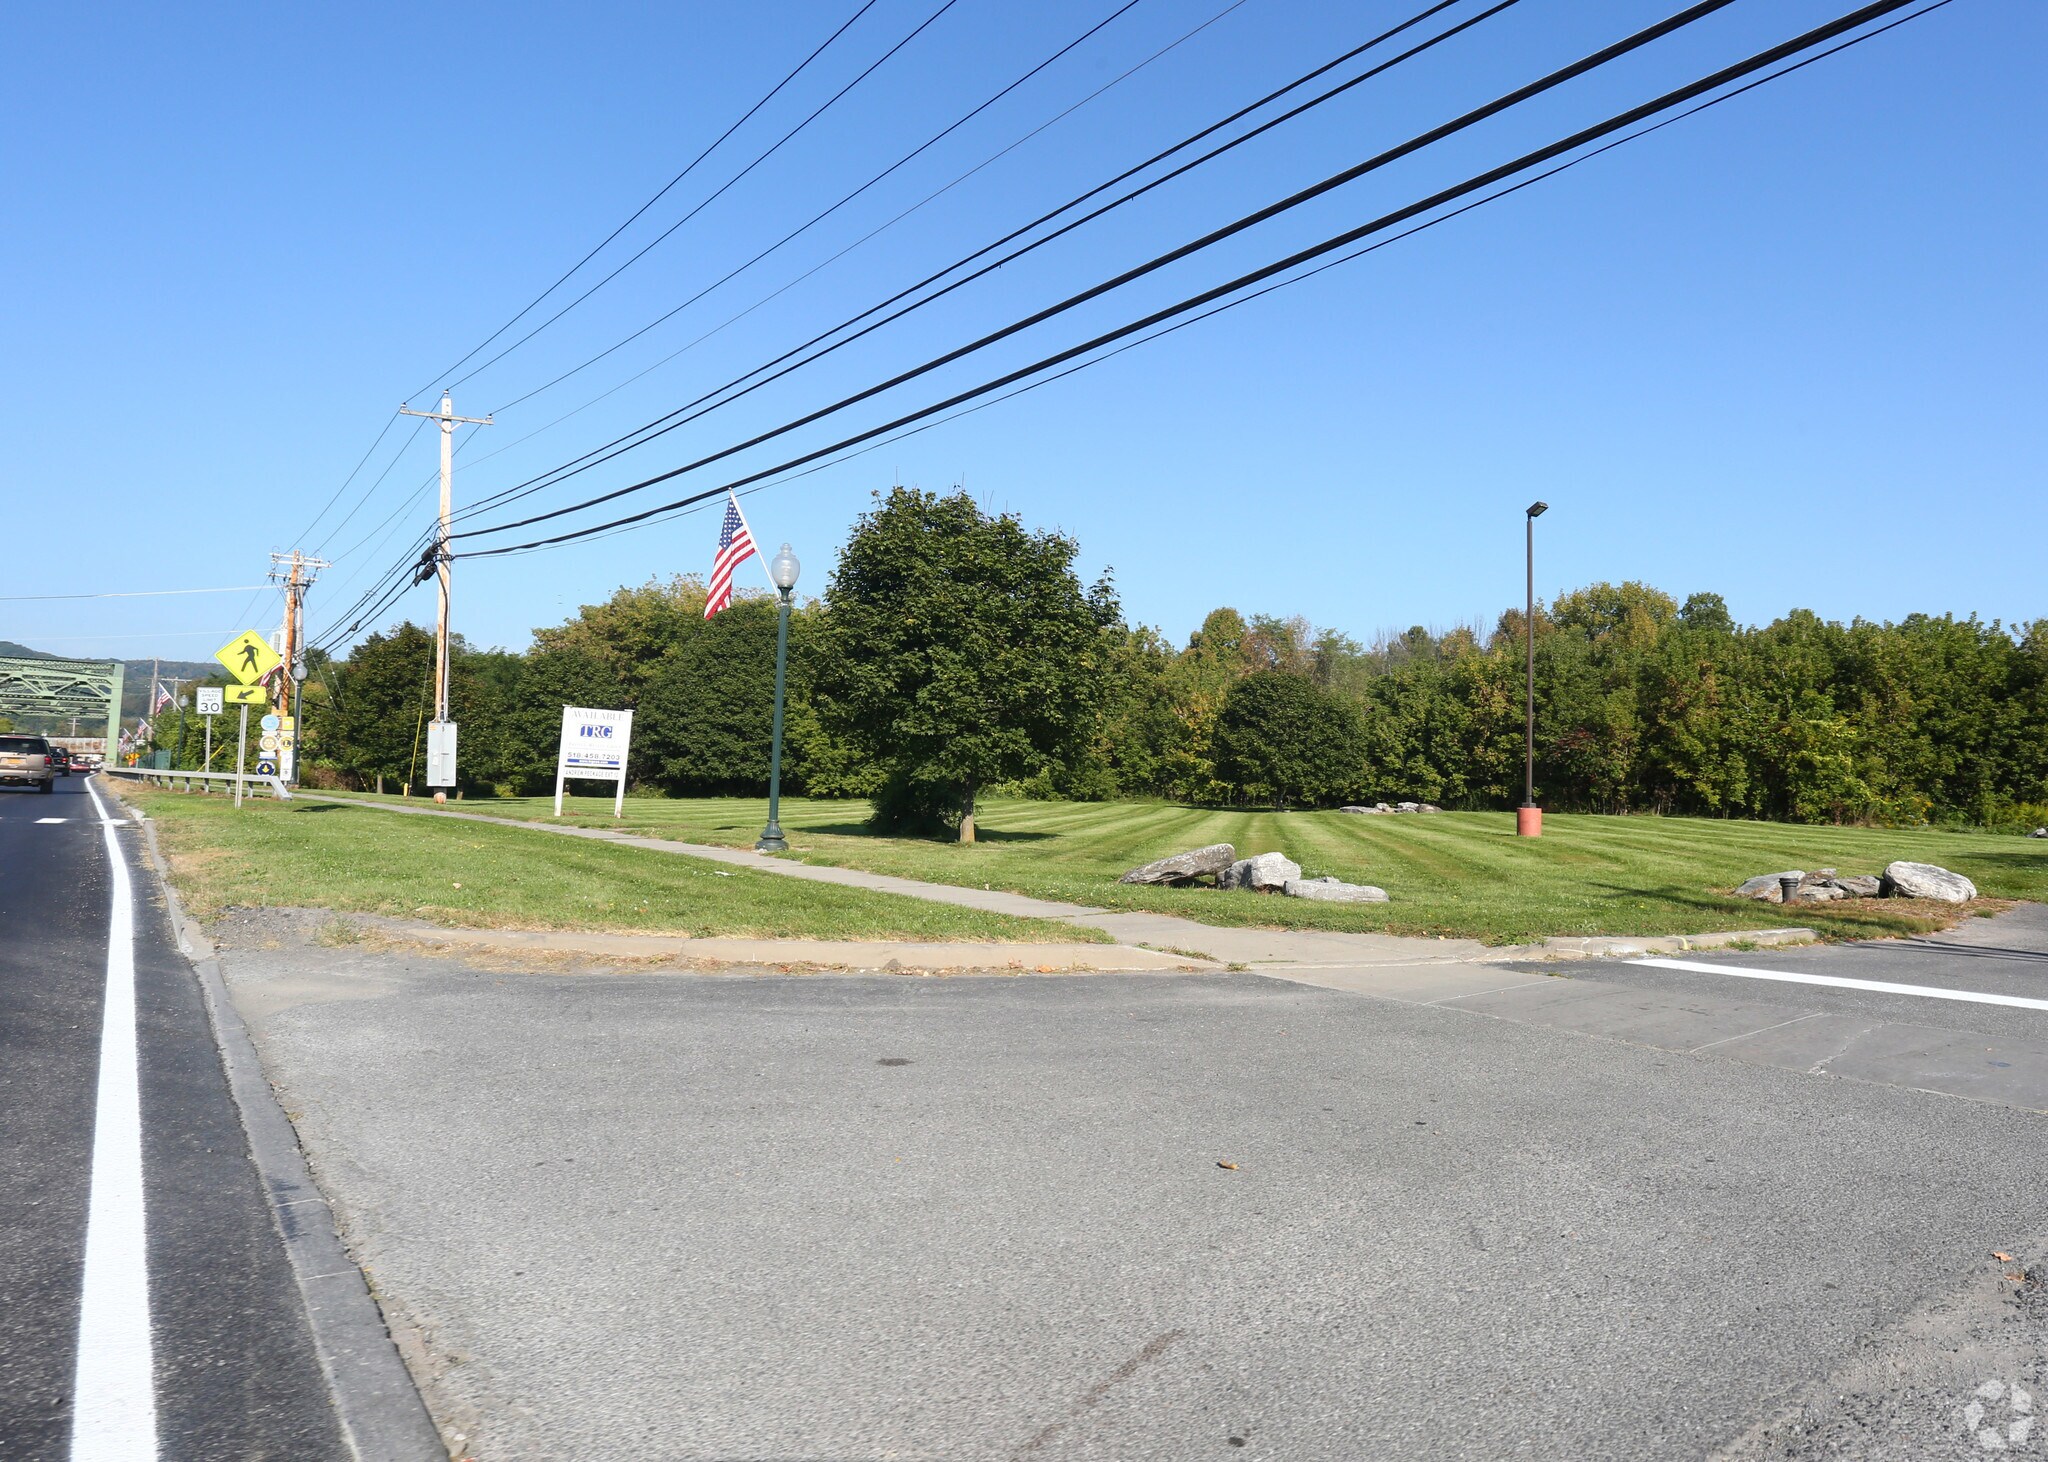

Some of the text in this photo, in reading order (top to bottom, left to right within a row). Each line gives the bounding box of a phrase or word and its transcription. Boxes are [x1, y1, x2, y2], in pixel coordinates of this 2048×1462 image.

[200, 702, 220, 712] 30
[571, 710, 624, 720] AVAILABLE
[580, 724, 613, 738] TRG
[567, 752, 620, 760] 518.458.7203
